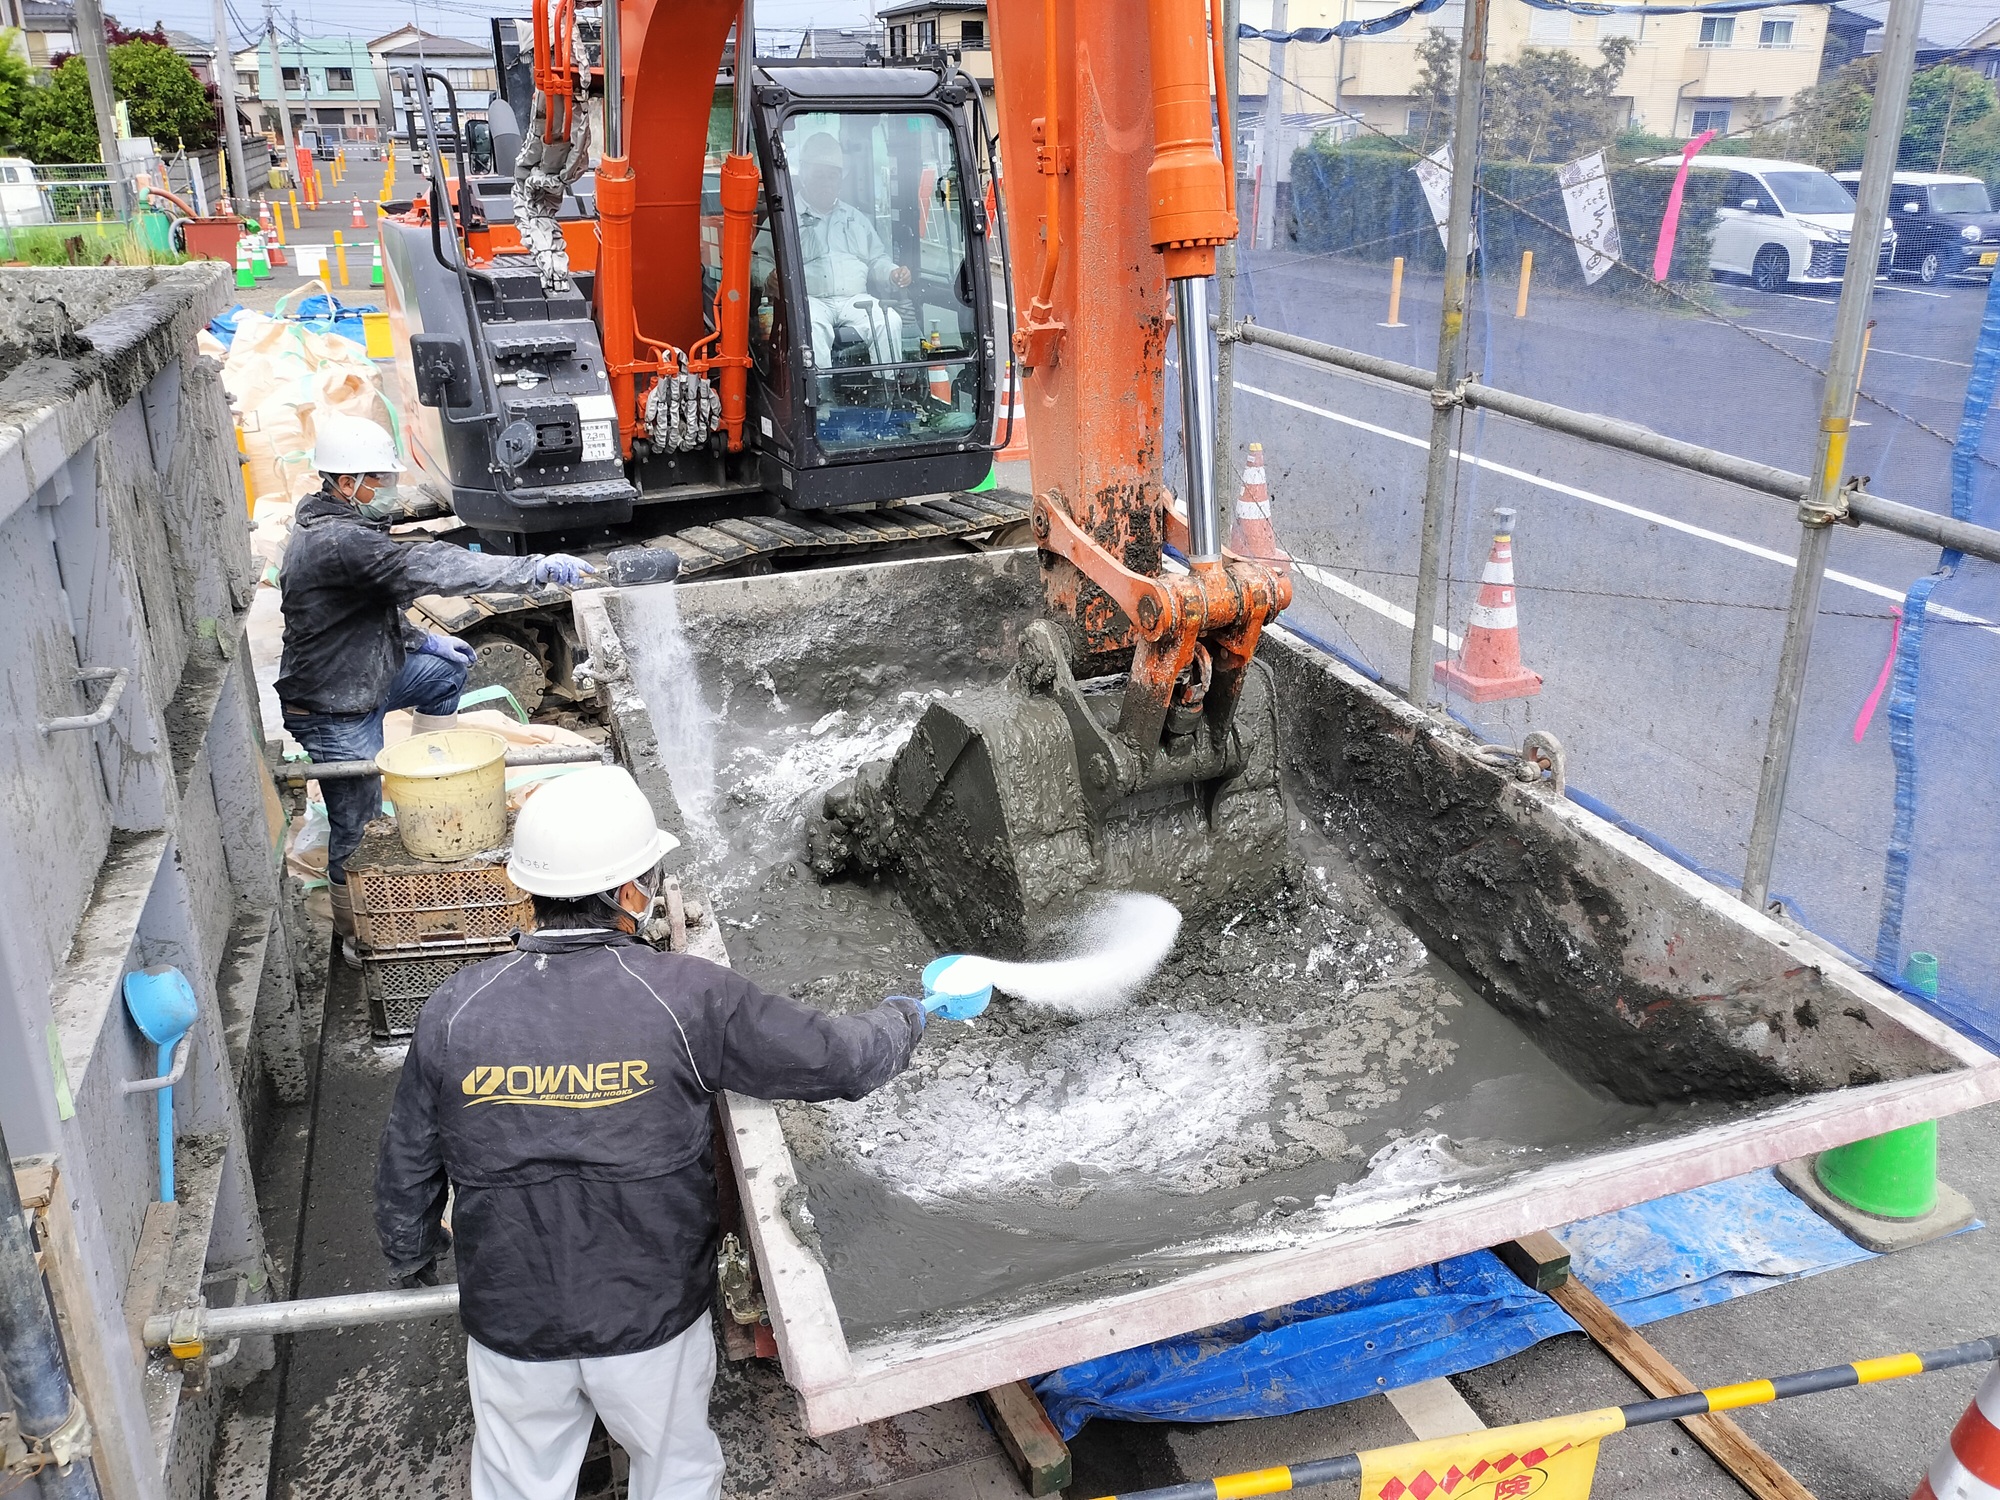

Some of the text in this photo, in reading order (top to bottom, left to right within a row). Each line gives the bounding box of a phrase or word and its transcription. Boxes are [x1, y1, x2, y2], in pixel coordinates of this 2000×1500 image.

[506, 1060, 649, 1095] OWNER
[591, 1091, 602, 1099] IN
[603, 1088, 634, 1098] HOOKS
